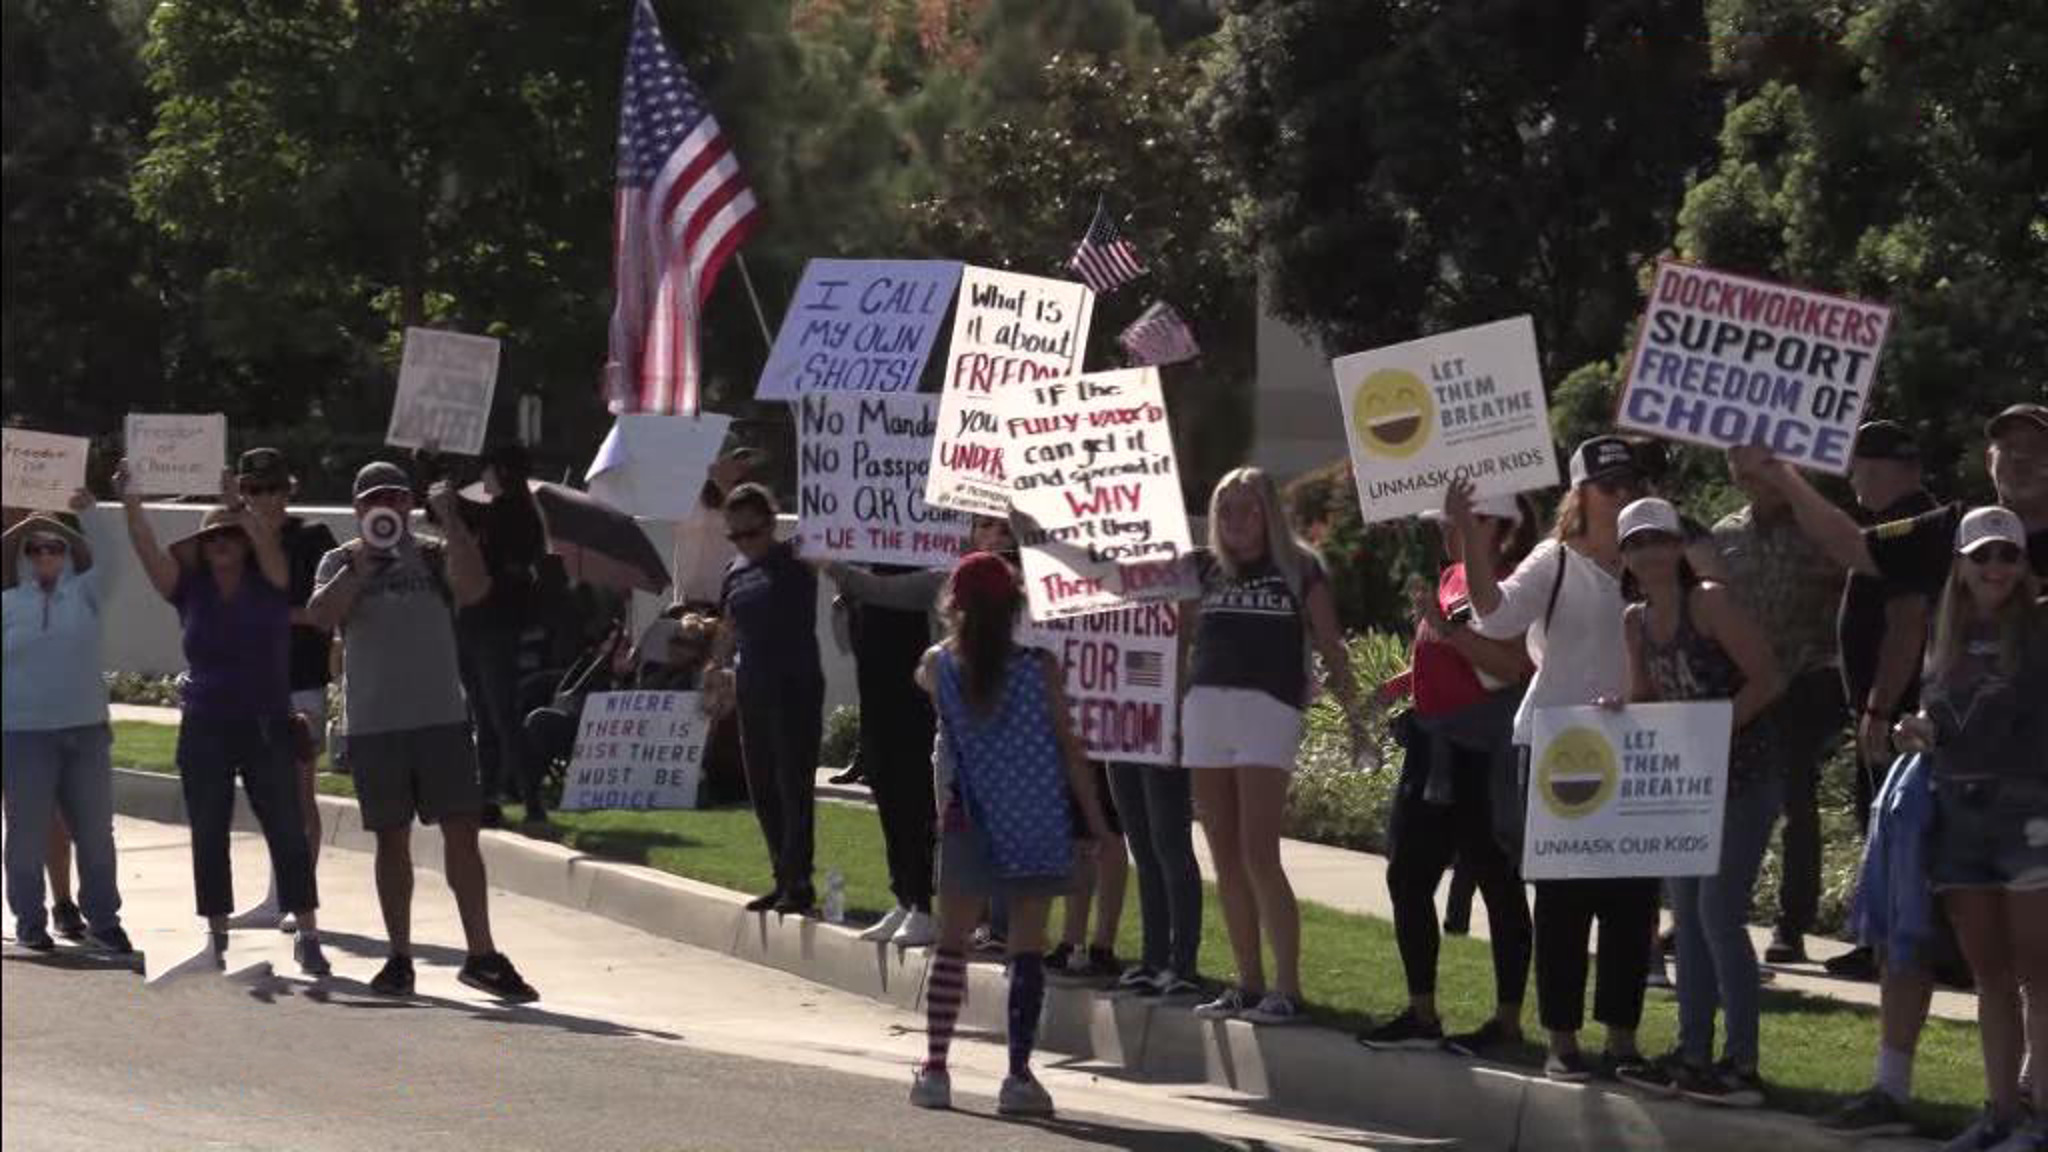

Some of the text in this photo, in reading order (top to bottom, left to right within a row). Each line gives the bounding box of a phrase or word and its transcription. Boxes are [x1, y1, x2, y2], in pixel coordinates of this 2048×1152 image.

[804, 278, 938, 314] I CALL
[972, 283, 1026, 318] What
[1659, 270, 1881, 347] DOCKWORKERS
[801, 320, 925, 354] MY OWN
[995, 322, 1073, 359] about
[1651, 310, 1870, 384] SUPPORT
[795, 353, 919, 393] SHOTS!
[1431, 358, 1465, 381] LET
[1638, 348, 1859, 423] FREEDOM OF
[1435, 376, 1495, 403] THEM
[802, 394, 845, 435] No
[1441, 390, 1534, 428] BREATHE
[1627, 388, 1850, 466] CHOICE
[802, 443, 840, 478] No
[941, 441, 1006, 480] UNDER
[1025, 442, 1074, 464] can
[1014, 468, 1064, 490] and
[1368, 449, 1545, 500] UNMASK OUR KIDS
[802, 484, 838, 518] No
[854, 486, 899, 525] QR
[1064, 482, 1141, 518] WHY
[868, 529, 903, 549] THE
[1101, 519, 1152, 542] they
[1063, 638, 1119, 692] FOR
[605, 693, 675, 713] WHERE
[586, 719, 691, 737] THERE IS
[1066, 698, 1163, 755] EEDOM
[1623, 730, 1656, 750] LET
[630, 743, 699, 762] THERE
[1622, 754, 1681, 774] THEM
[655, 768, 684, 785] BE
[1620, 776, 1714, 798] BREATHE
[1534, 834, 1709, 857] UNMASK OUR KIDS
